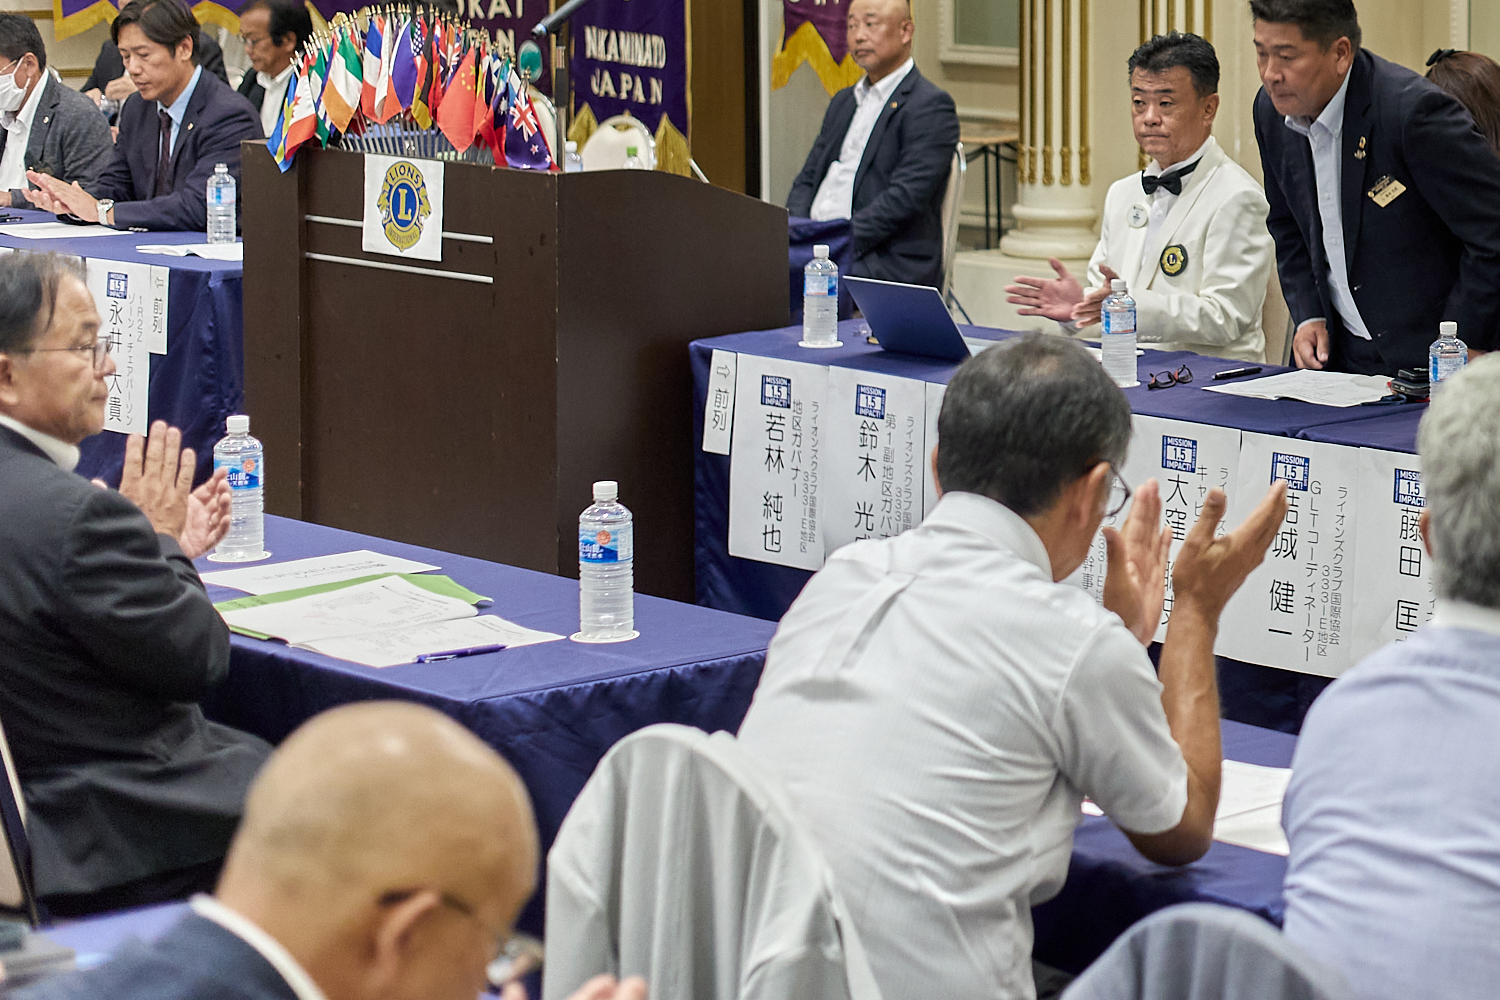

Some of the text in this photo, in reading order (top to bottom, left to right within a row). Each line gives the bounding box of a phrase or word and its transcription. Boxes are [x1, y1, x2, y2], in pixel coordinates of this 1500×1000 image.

[590, 67, 663, 106] JAPAN
[389, 164, 421, 185] LIONS
[397, 188, 412, 220] L
[109, 300, 123, 354] 永井
[136, 295, 144, 343] 1R2Z
[152, 297, 163, 334] 前列
[712, 387, 730, 432] 前列
[790, 399, 803, 498] 地区ガバナー
[857, 419, 879, 482] 鈴木
[1167, 436, 1193, 449] MISSION
[1173, 448, 1186, 461] 1.5
[1277, 453, 1305, 466] MISSION
[762, 411, 787, 554] 若林 純也
[1166, 459, 1192, 472] IMPACT!
[1283, 464, 1297, 479] 1.5
[1285, 479, 1304, 490] PACT!
[1165, 473, 1189, 541] 大窪
[1399, 506, 1424, 578] 藤田
[1302, 480, 1322, 662] GLTコーディネーター
[1329, 486, 1348, 646] ライオンズクラブ国際協会
[1268, 578, 1296, 636] 健一
